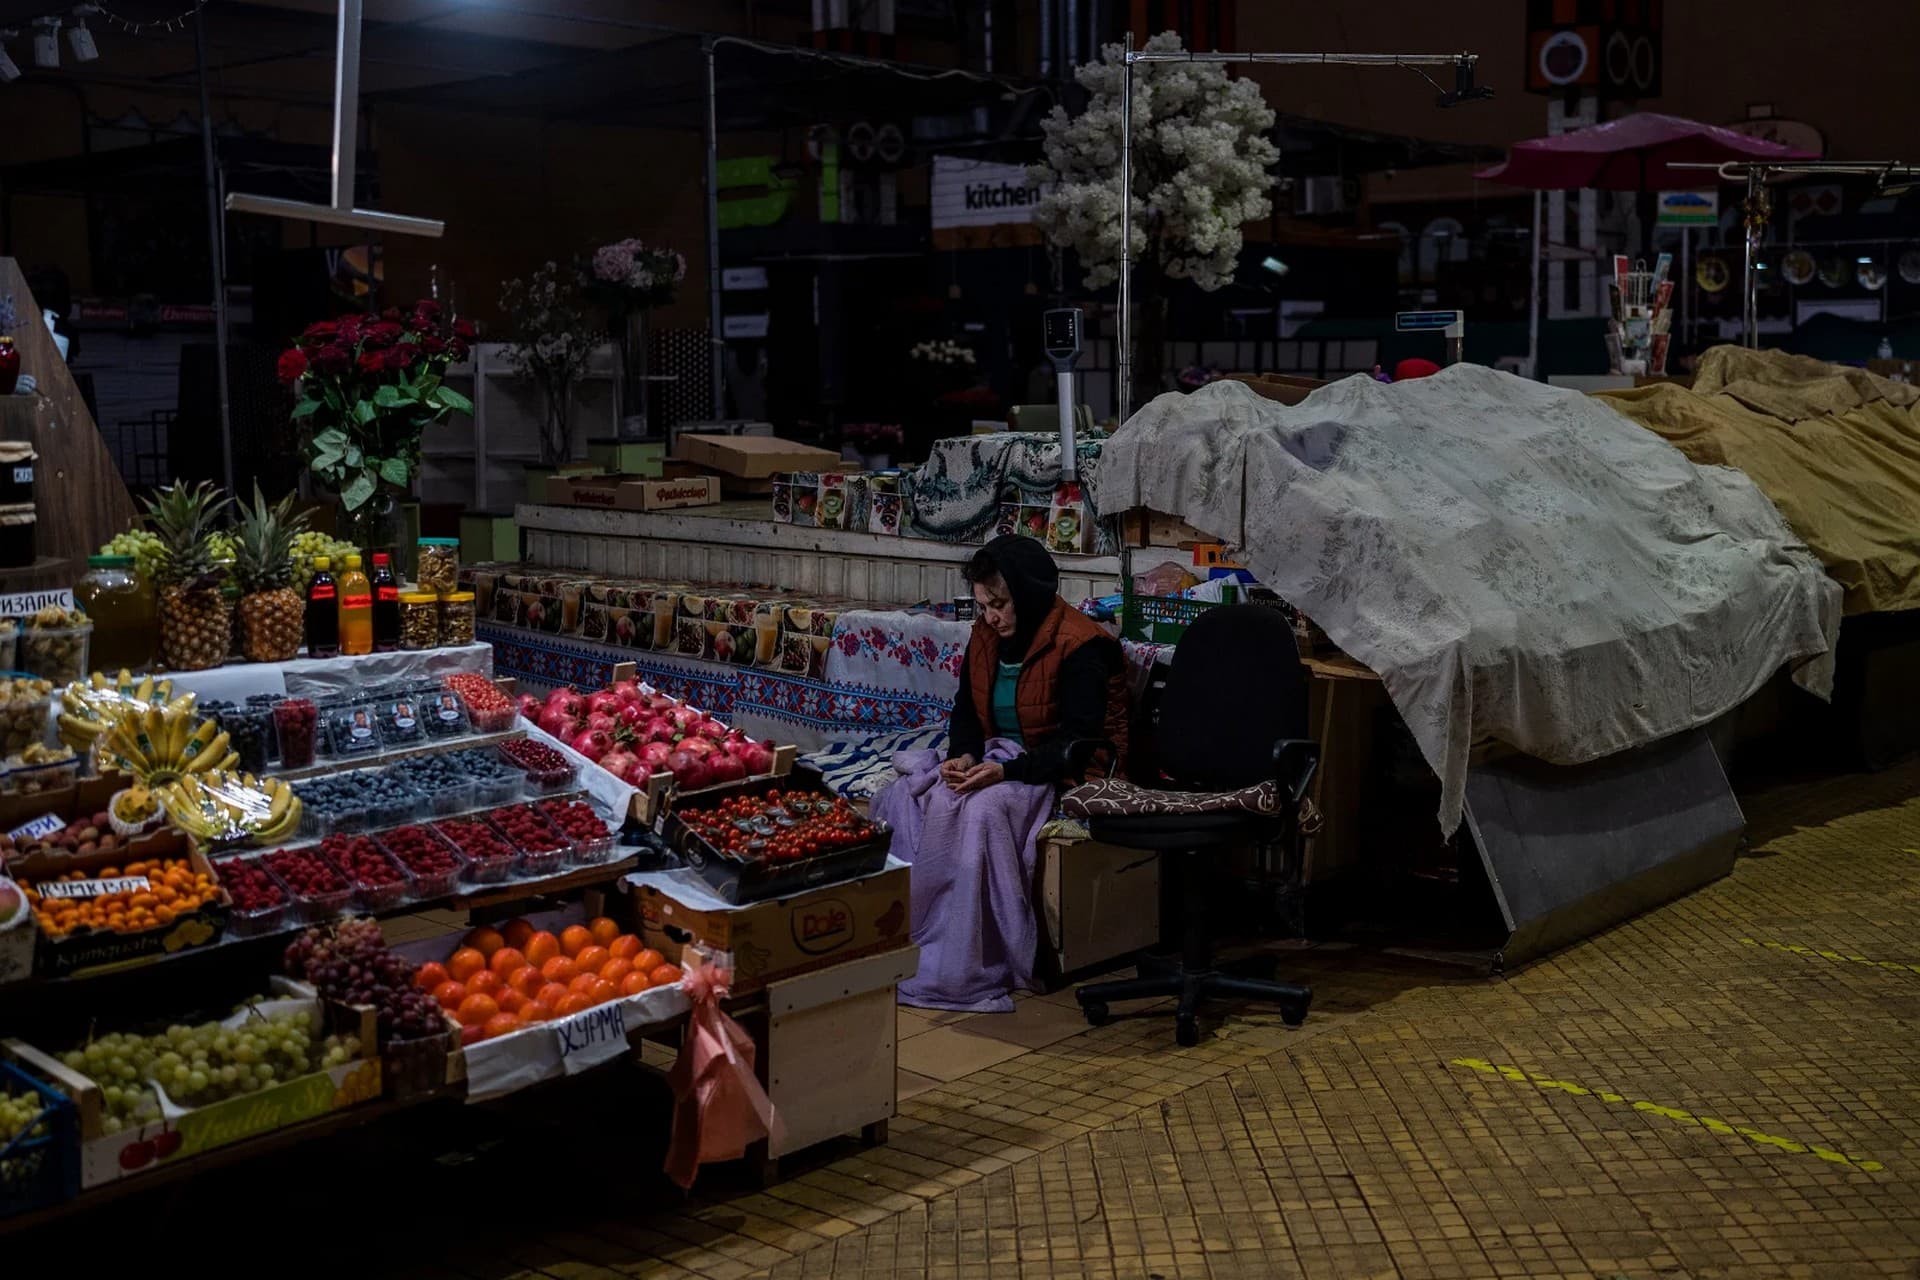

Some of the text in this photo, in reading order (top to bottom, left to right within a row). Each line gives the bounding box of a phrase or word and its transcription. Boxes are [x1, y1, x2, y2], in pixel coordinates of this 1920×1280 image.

[966, 182, 1039, 209] kitchen
[0, 590, 69, 613] ИЗАЛИС
[803, 908, 846, 937] Dole
[558, 1003, 625, 1057] ХУРМА
